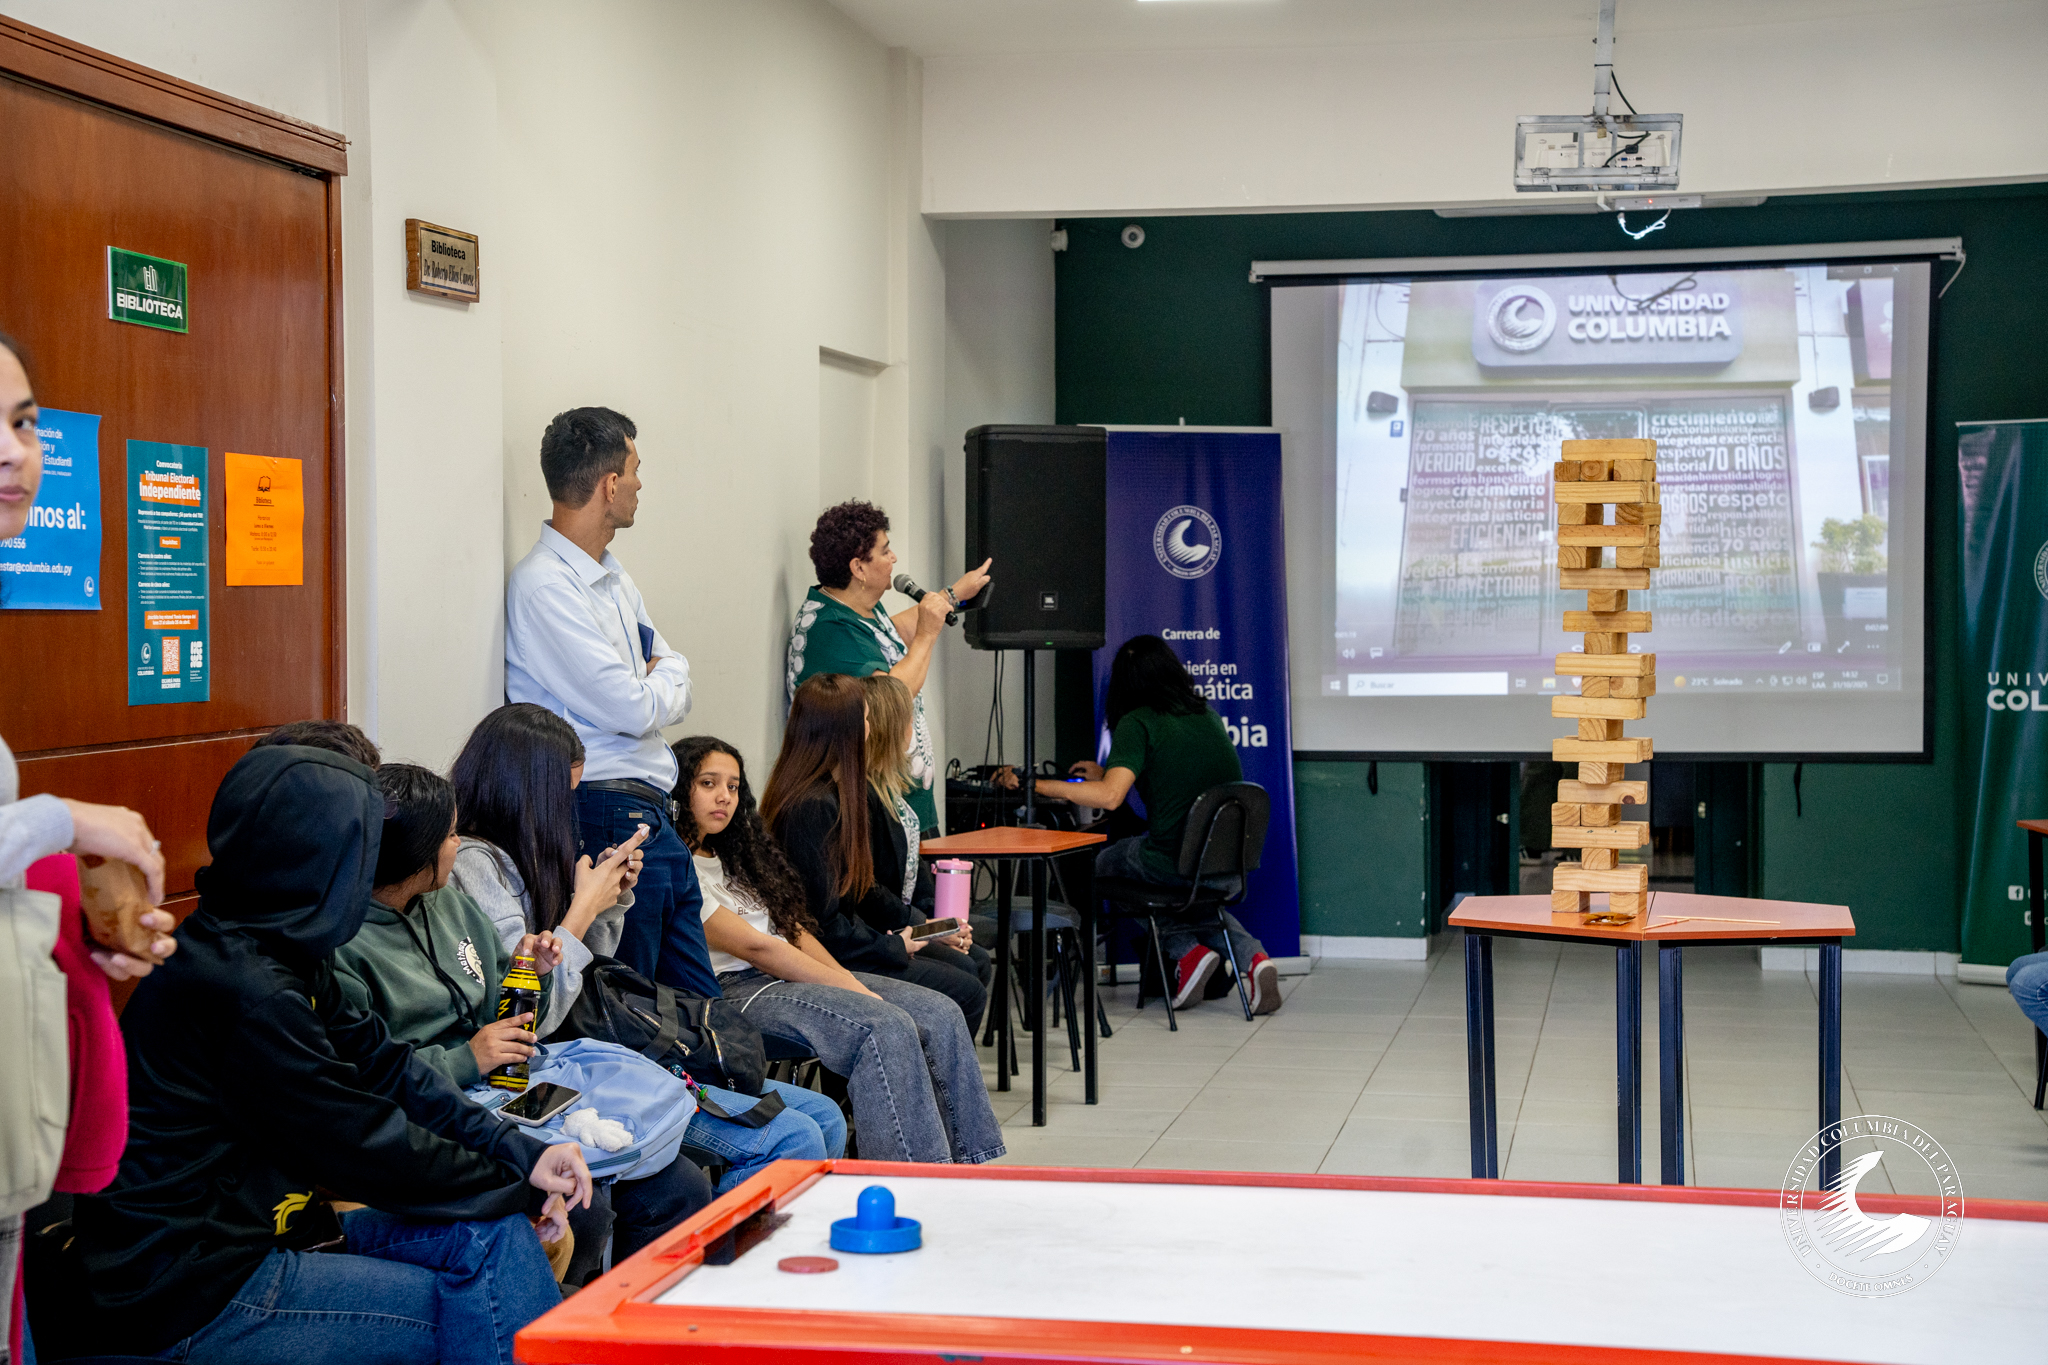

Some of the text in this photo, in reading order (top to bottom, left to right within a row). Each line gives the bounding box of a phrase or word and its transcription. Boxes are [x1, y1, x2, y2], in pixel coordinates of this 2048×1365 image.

[431, 240, 466, 260] Biblioteca
[116, 292, 183, 320] BIBLIOTECA
[1567, 315, 1733, 340] COLUMBIA
[1651, 410, 1757, 426] crecimiento
[1651, 424, 1709, 438] trayectoria
[44, 455, 72, 467] Estudiantil
[156, 459, 183, 469] Convocatoria
[1415, 451, 1476, 473] VERDAD
[1706, 446, 1729, 471] 70
[1734, 444, 1786, 470] AÑOS
[145, 470, 195, 484] Tribunal Electoral
[139, 481, 201, 501] Independiente
[1452, 482, 1545, 497] crecimiento
[1482, 496, 1545, 511] historia
[1661, 493, 1708, 514] OGROS
[66, 502, 86, 530] al:
[1491, 509, 1545, 525] justicia
[13, 538, 26, 549] 556
[1162, 627, 1220, 640] Carrera de
[1220, 663, 1237, 675] en
[1370, 681, 1395, 689] Buscar
